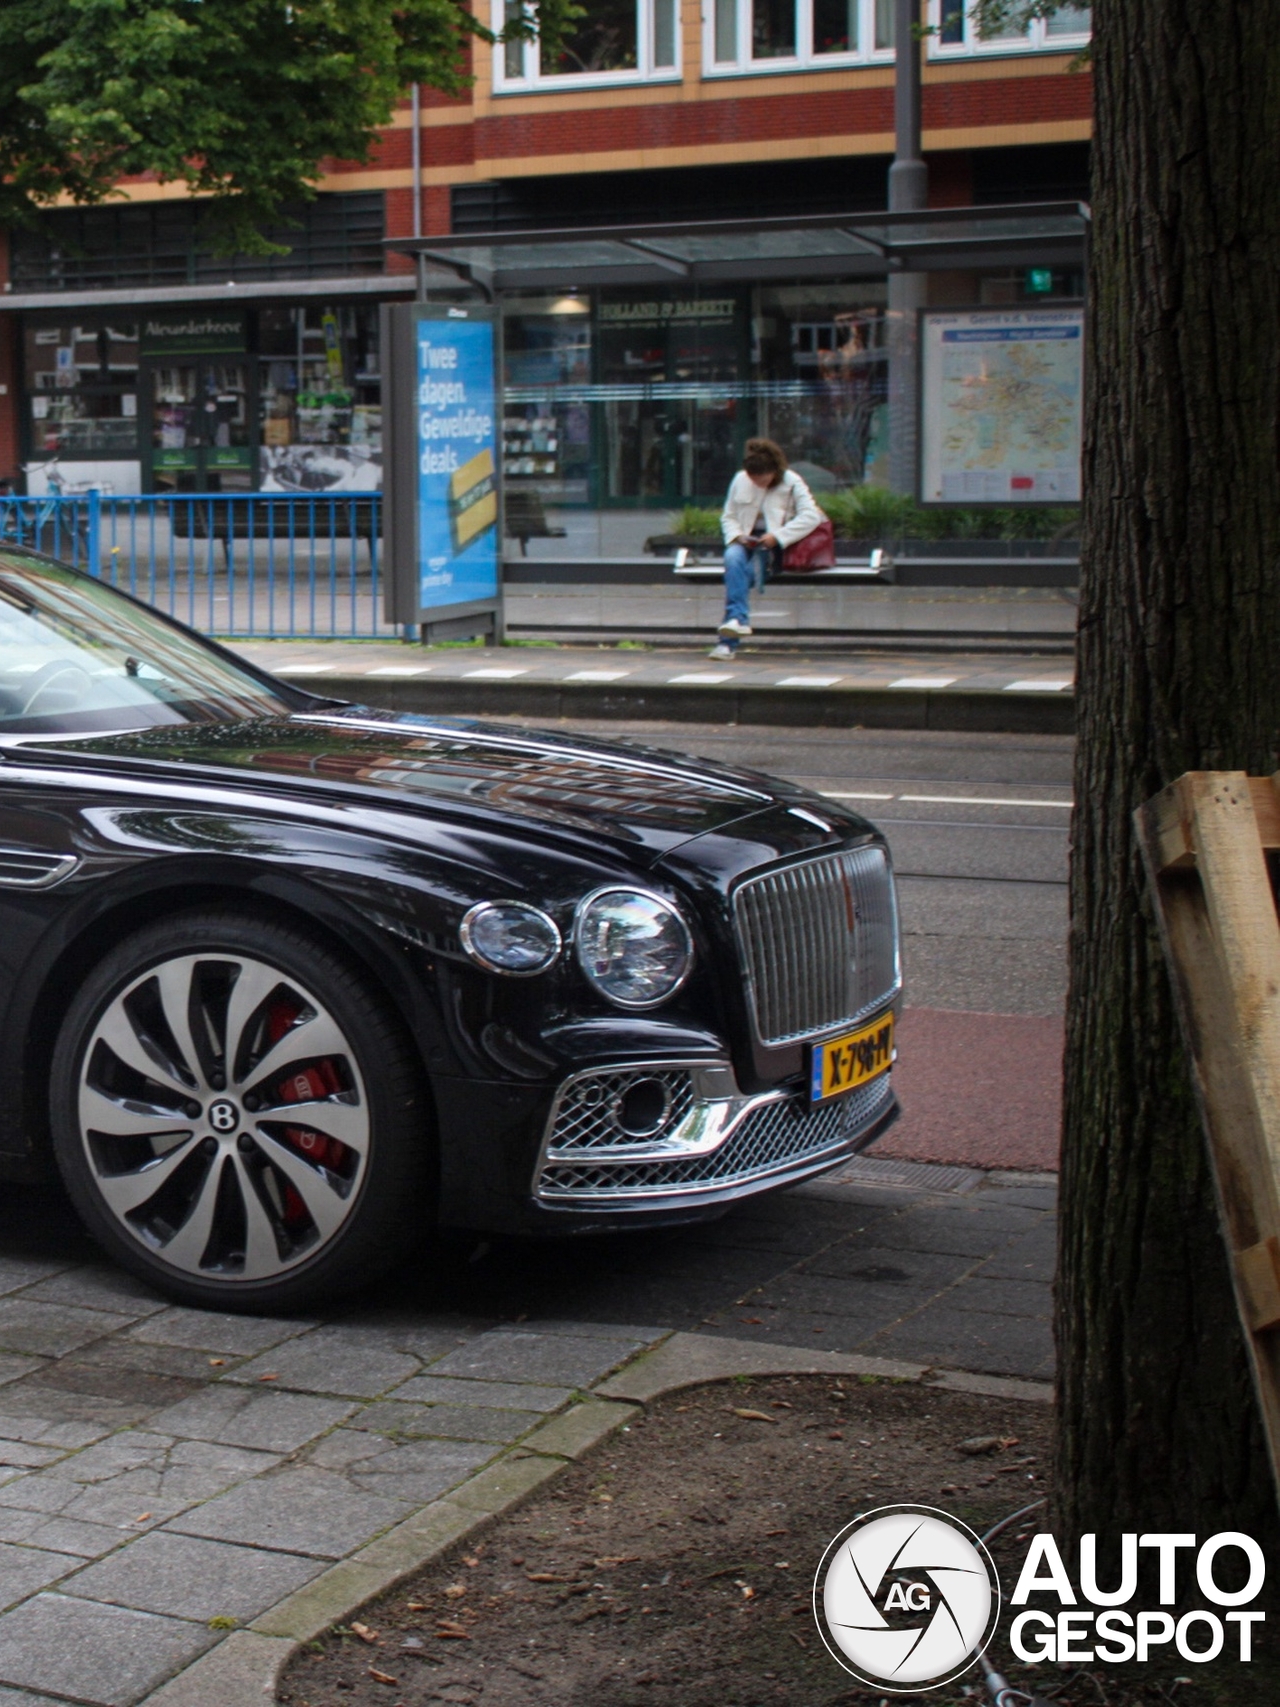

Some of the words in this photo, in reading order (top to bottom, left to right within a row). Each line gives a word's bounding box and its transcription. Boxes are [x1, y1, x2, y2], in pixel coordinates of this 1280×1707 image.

[419, 341, 458, 369] Twee
[420, 375, 466, 411] dagen.
[420, 409, 492, 444] Geweldige
[420, 444, 460, 475] deals.
[211, 1104, 235, 1129] B
